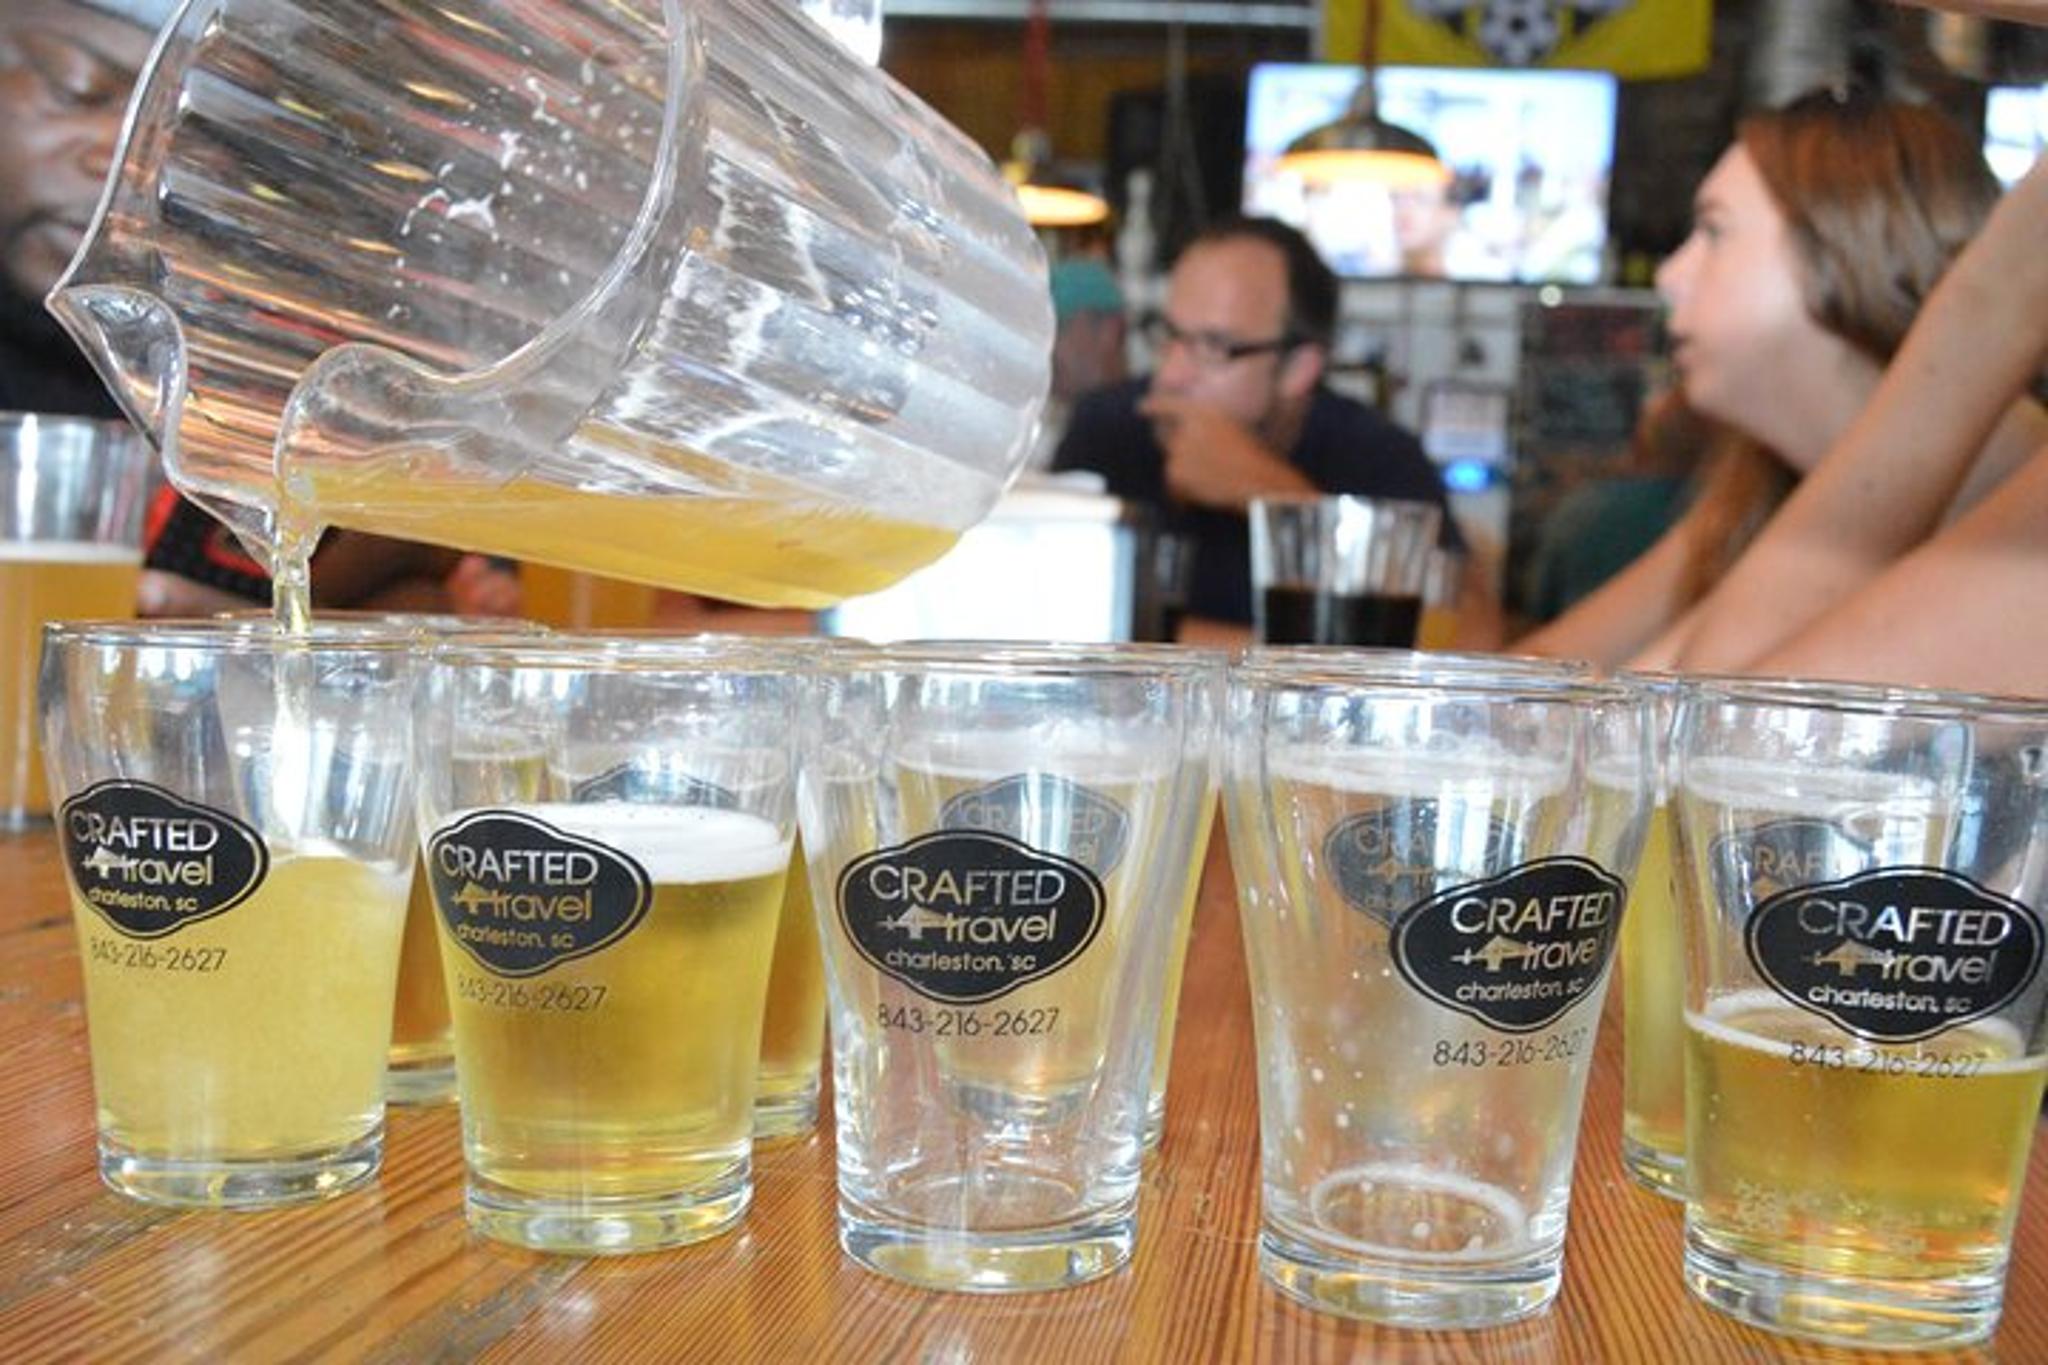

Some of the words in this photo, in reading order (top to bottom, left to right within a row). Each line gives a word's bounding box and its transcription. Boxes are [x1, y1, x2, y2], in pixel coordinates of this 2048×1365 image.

[70, 809, 219, 852] CRAFTED
[121, 854, 214, 886] travel
[439, 843, 600, 886] CRAFTED
[869, 864, 1066, 906] CRAFTED
[490, 888, 593, 923] travel
[1452, 892, 1614, 934] CRAFTED
[945, 908, 1057, 943] travel
[1799, 901, 2012, 946] CRAFTED
[1011, 953, 1037, 970] sc
[1521, 936, 1603, 971] trave
[1880, 950, 1997, 984] travel
[876, 1003, 1060, 1036] 843-216-2627
[1945, 996, 1974, 1014] sc
[1788, 1039, 1988, 1079] 843-216-2627
